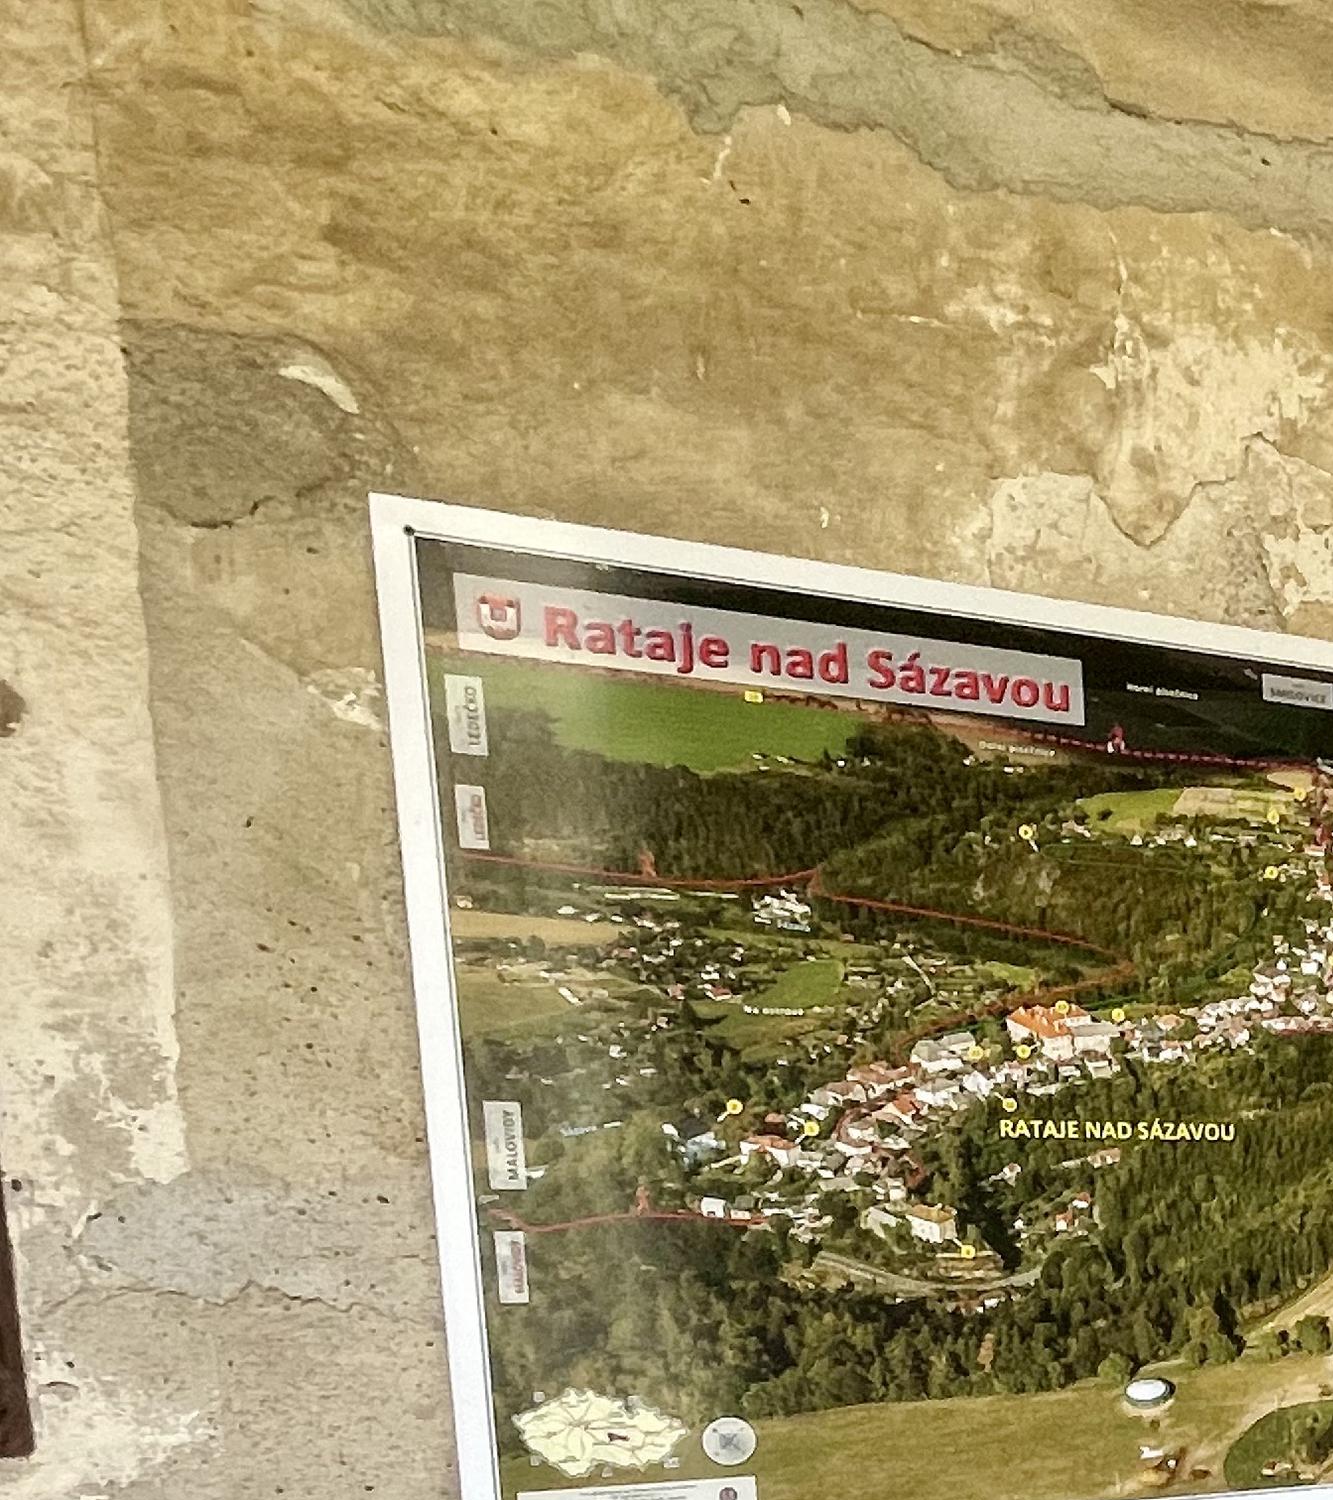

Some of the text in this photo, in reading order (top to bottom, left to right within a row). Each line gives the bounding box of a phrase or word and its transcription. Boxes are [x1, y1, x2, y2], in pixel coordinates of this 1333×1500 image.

[543, 605, 1072, 713] Rataje nad Sázavou
[464, 685, 482, 746] LEDEČKO
[502, 1109, 521, 1181] MALOVIDY
[1000, 1117, 1236, 1141] RATAJE NAD SÁZAVOU
